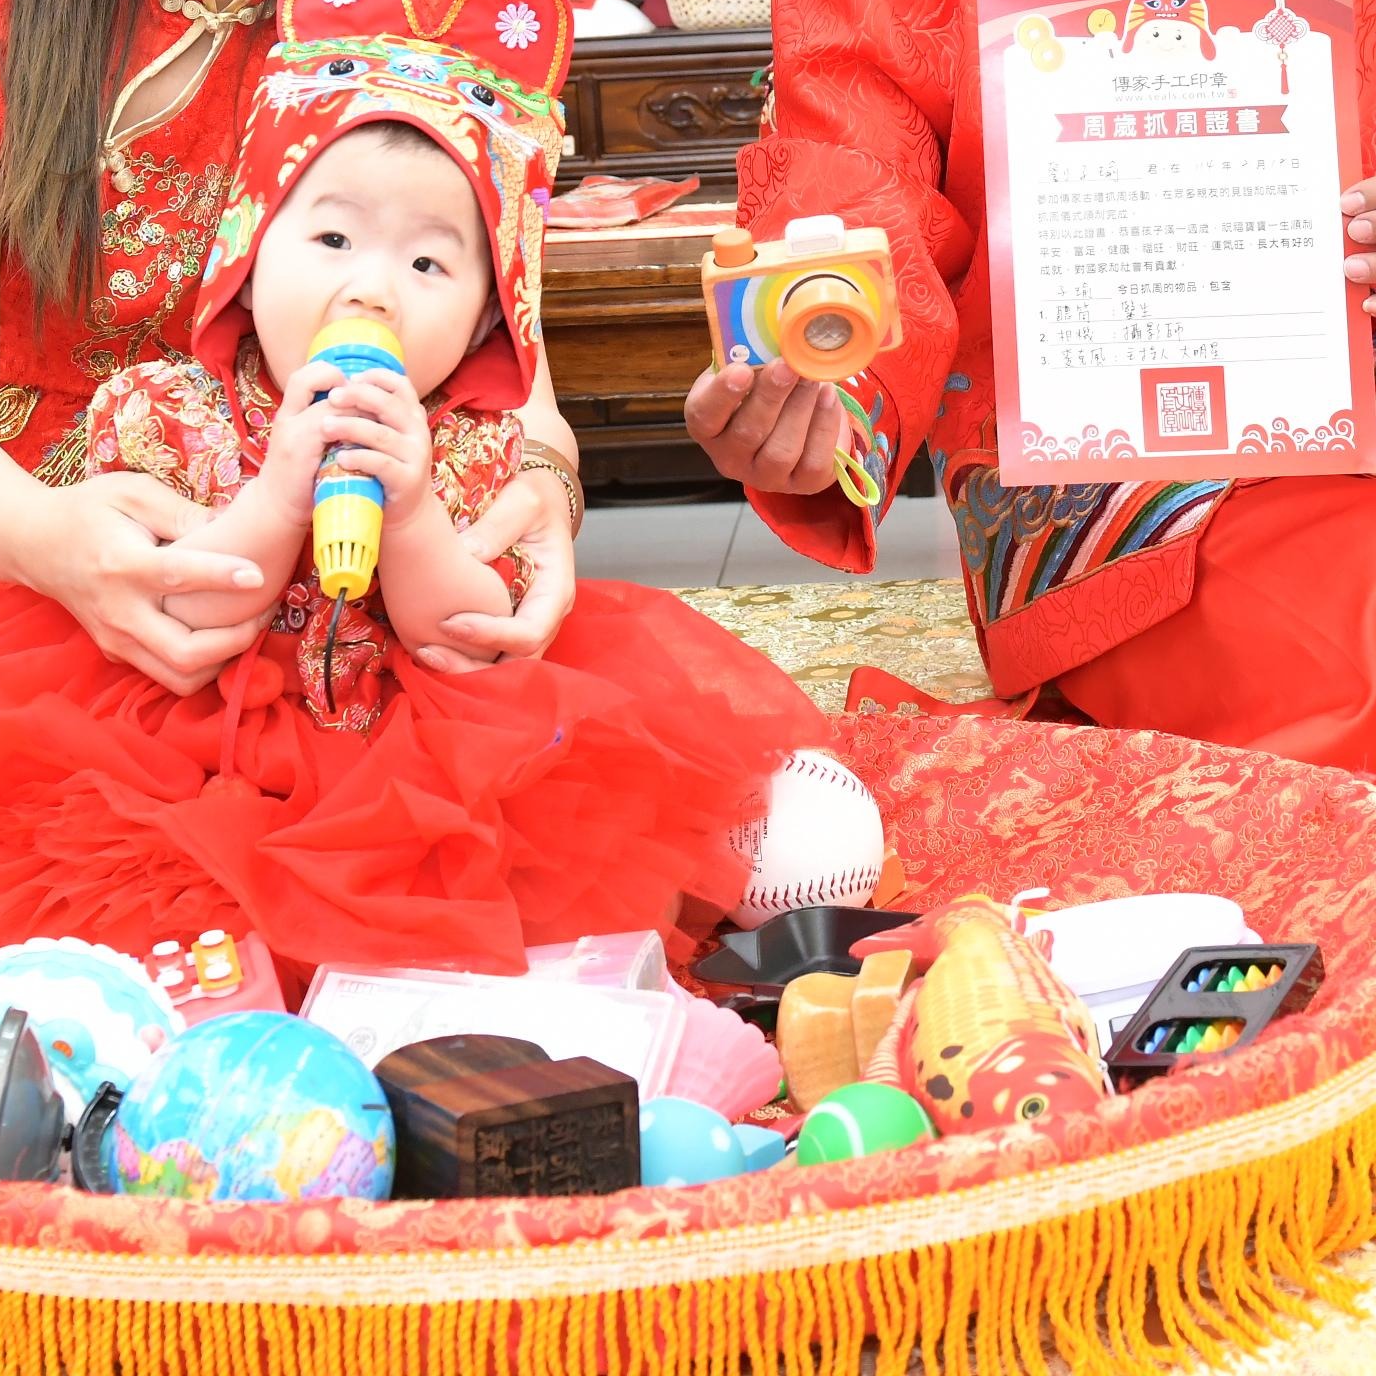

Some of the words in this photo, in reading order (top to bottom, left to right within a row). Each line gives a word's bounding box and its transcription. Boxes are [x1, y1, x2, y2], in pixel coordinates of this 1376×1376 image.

[1112, 71, 1228, 92] 傳家手工印章
[1082, 108, 1260, 139] 周歲抓周證書
